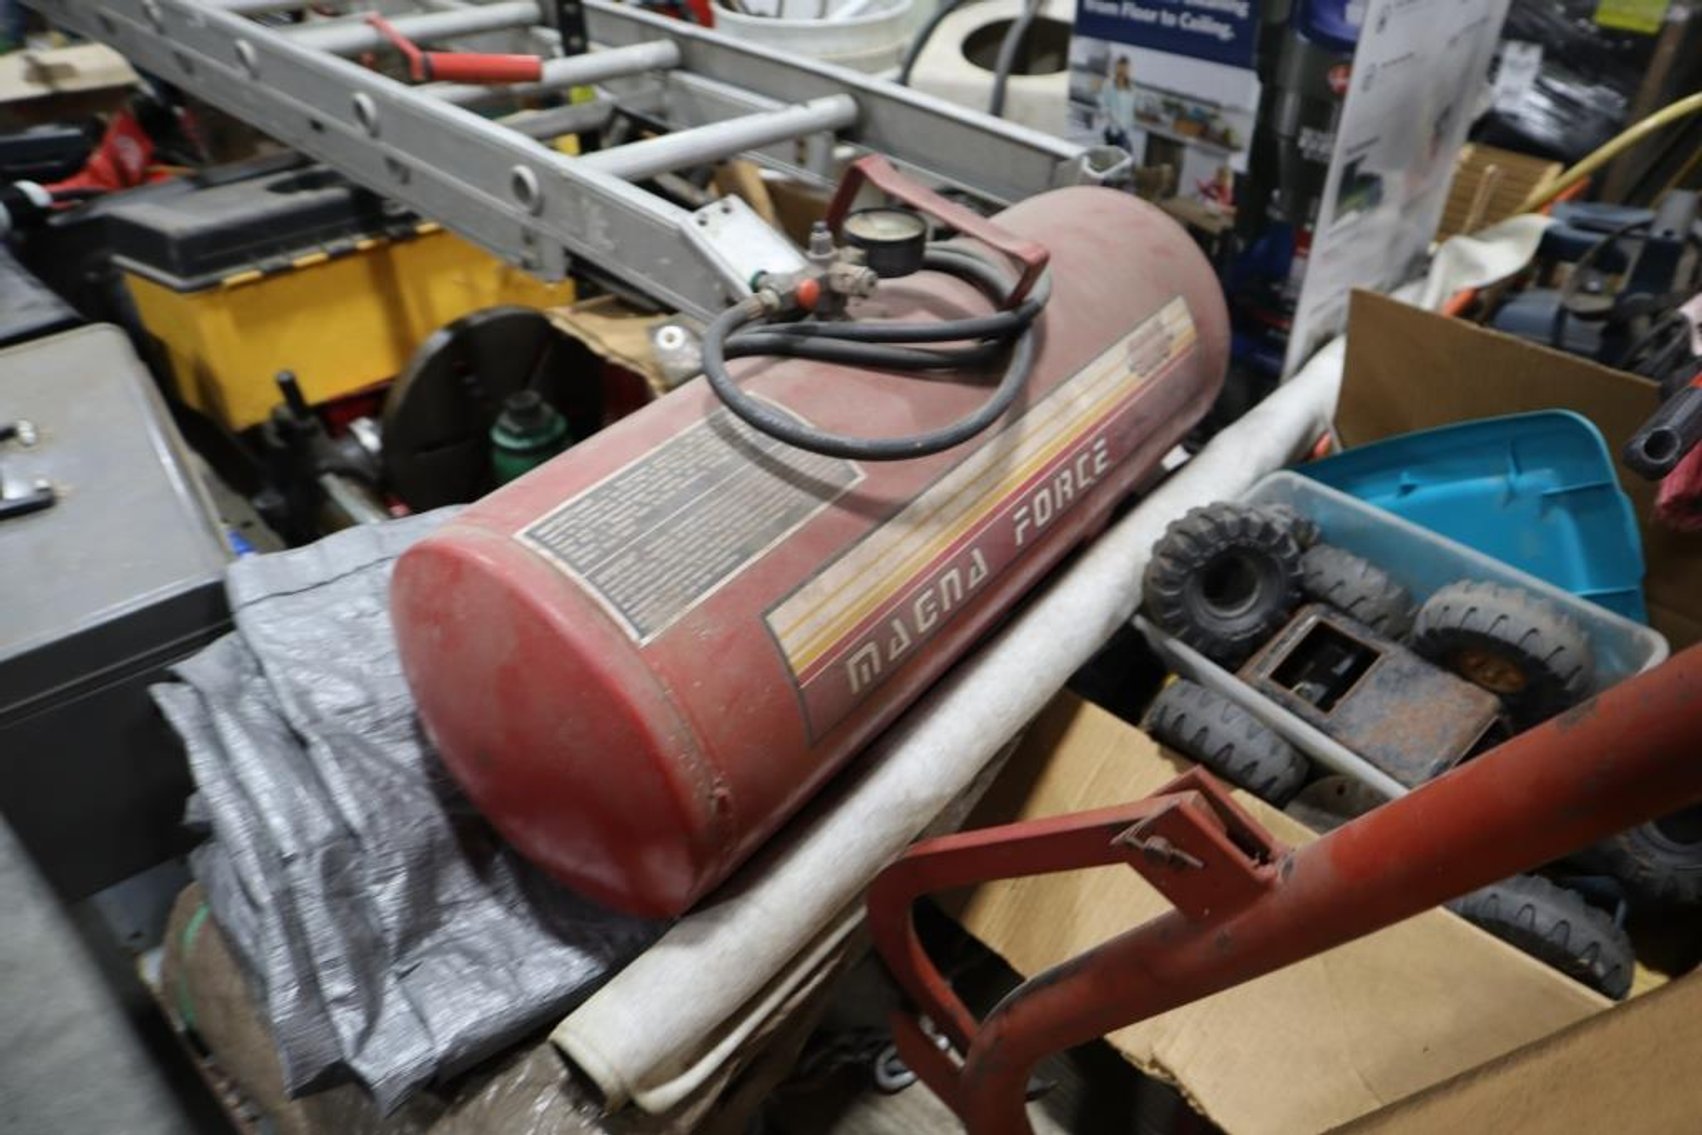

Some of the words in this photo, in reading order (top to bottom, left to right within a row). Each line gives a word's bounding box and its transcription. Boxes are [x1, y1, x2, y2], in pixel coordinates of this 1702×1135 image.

[1121, 2, 1158, 23] Floor
[1160, 11, 1177, 27] to
[845, 547, 989, 695] MAGNA
[1013, 438, 1110, 546] FORCE
